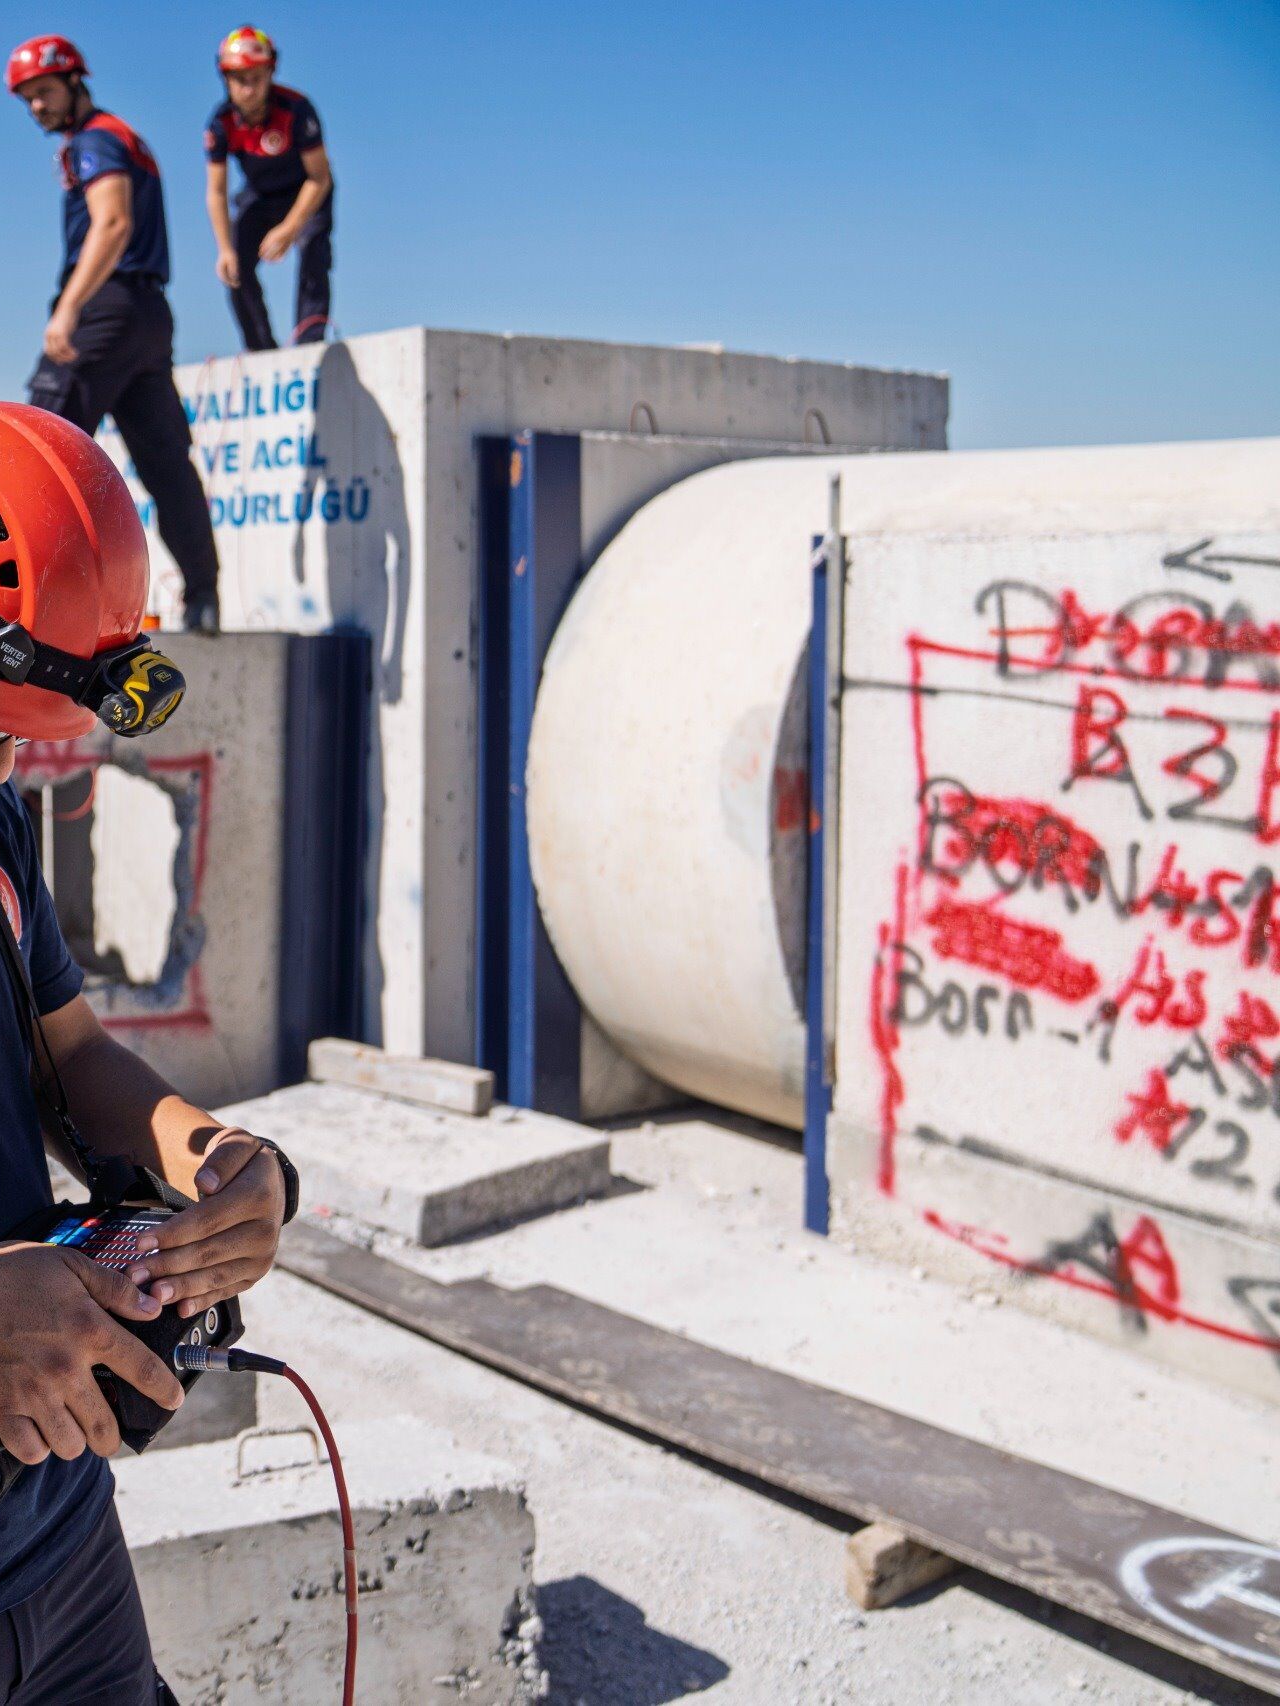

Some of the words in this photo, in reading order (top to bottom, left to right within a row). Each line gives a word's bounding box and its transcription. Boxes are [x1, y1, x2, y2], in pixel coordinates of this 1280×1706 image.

[202, 443, 240, 474] VE
[252, 425, 327, 470] ACİL
[209, 477, 370, 528] DÜRLÜĞÜ
[1, 641, 27, 662] VERTEX
[2, 654, 22, 669] VENT
